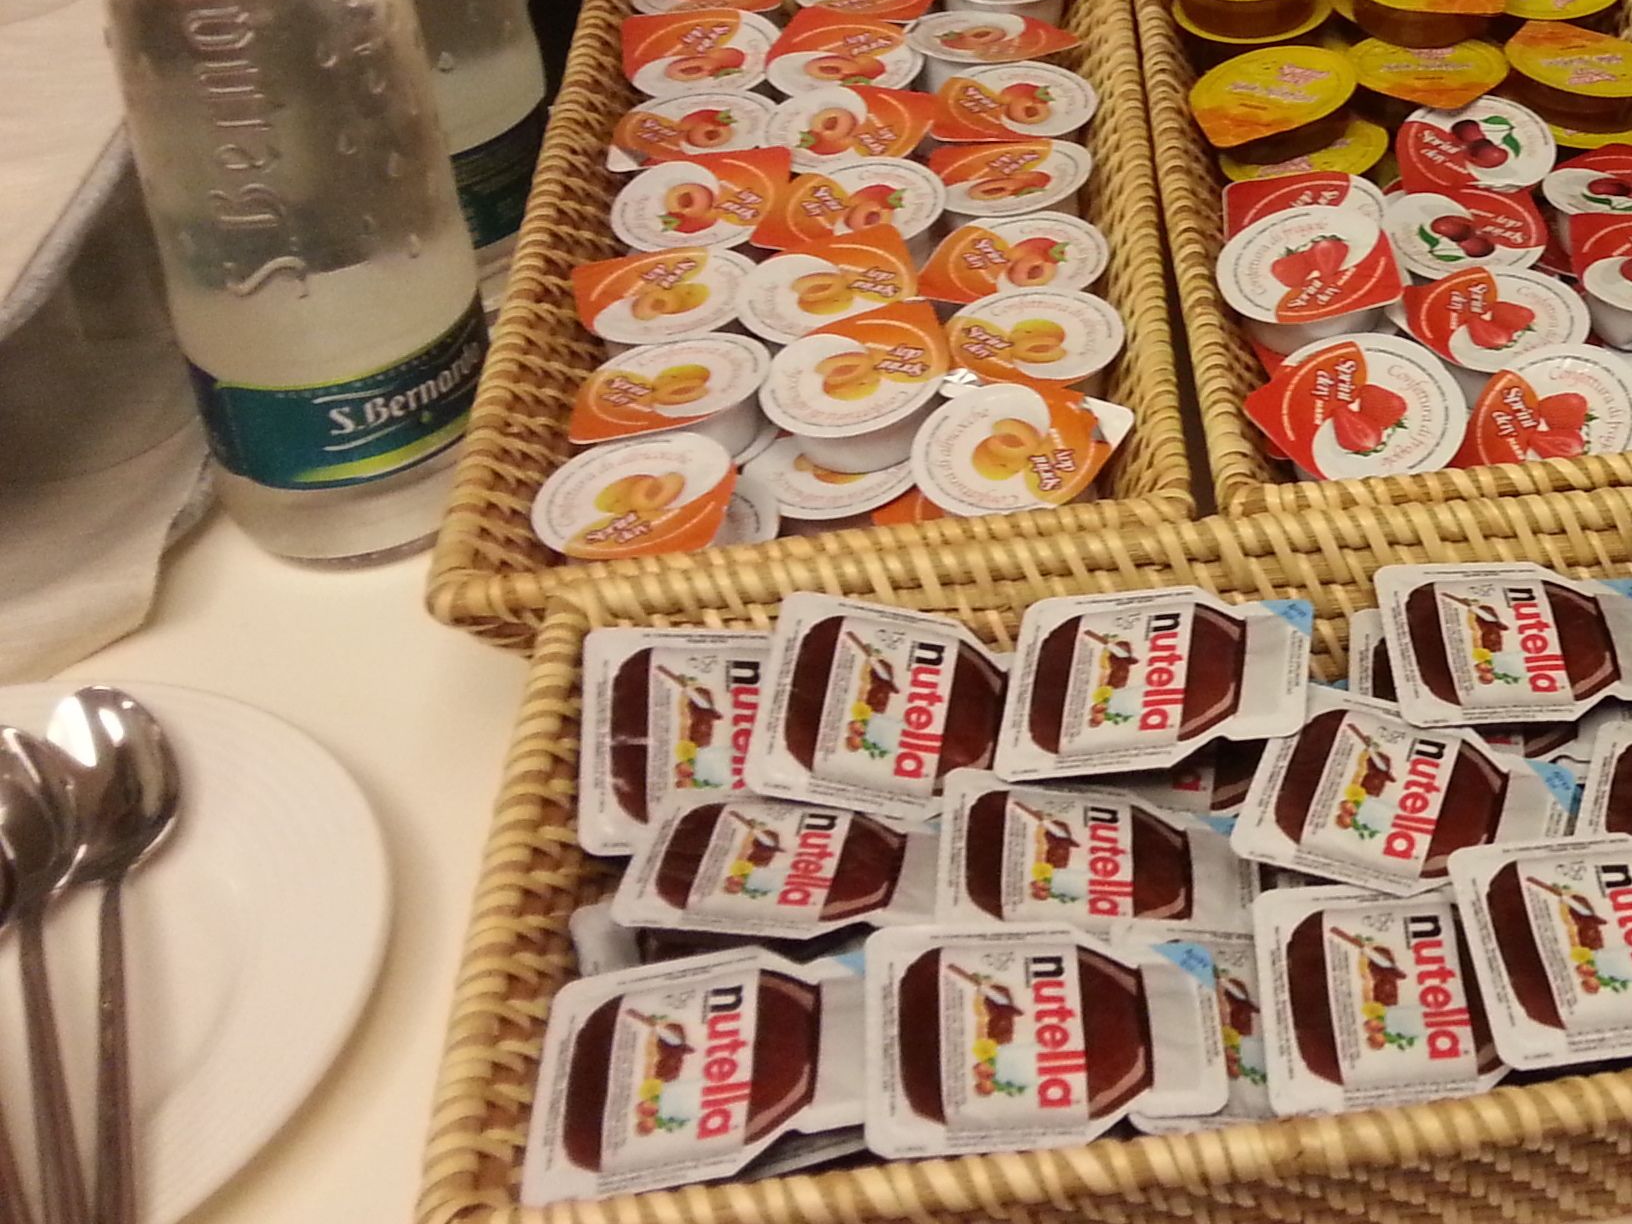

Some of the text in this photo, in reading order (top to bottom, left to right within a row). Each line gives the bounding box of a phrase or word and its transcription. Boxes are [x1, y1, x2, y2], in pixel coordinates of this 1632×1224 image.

[1335, 357, 1359, 402] Sprint
[1491, 410, 1519, 437] day
[1502, 386, 1540, 430] Sprint
[1028, 453, 1063, 492] Sprint
[1138, 612, 1186, 732] nutella
[1505, 586, 1567, 694] nutella
[893, 641, 946, 780] nutella
[1382, 738, 1448, 861] nutella
[776, 812, 838, 908] nutella
[1087, 805, 1134, 918] nutella
[1031, 955, 1088, 1109] nutella
[1409, 914, 1472, 1061] nutella
[696, 984, 752, 1141] nutella
